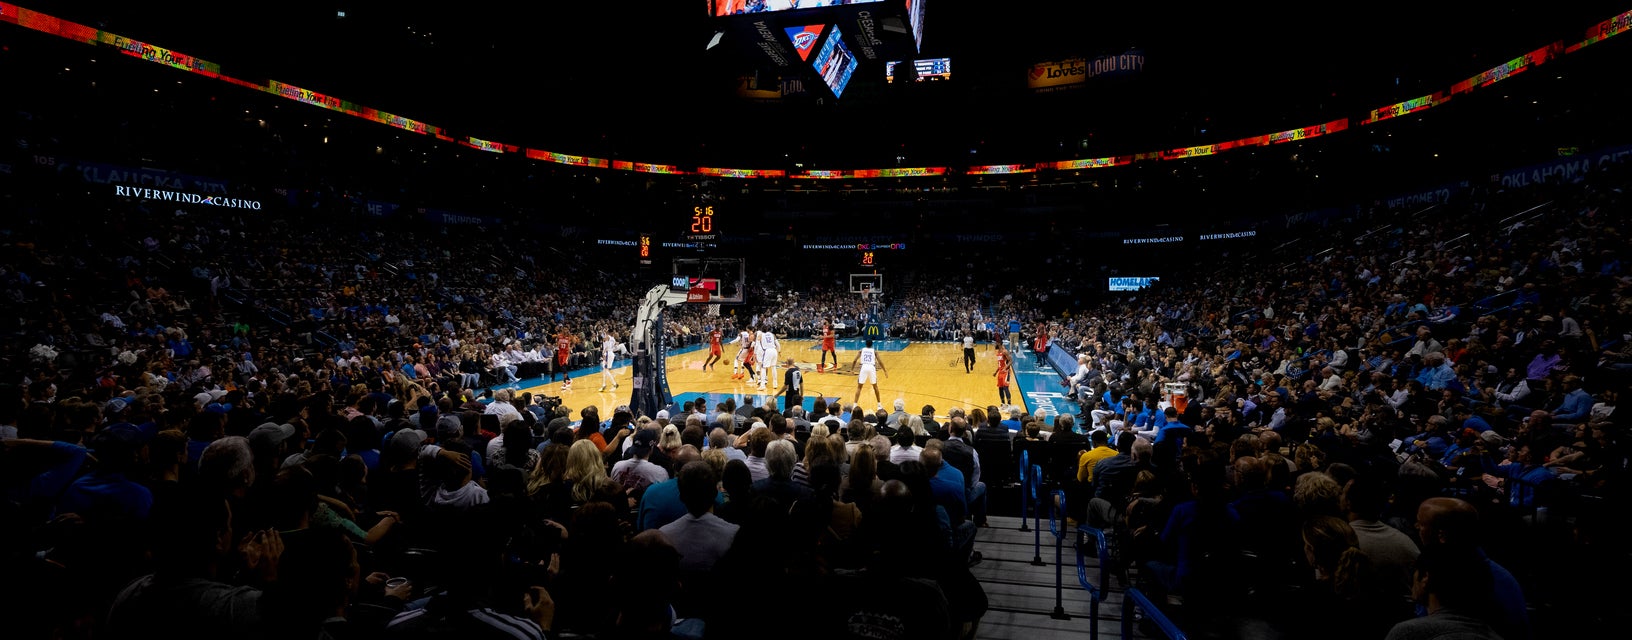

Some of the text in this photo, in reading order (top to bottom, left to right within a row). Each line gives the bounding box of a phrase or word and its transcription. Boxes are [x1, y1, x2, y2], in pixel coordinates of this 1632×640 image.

[115, 36, 156, 60] Fueling
[159, 49, 187, 66] Your
[1088, 54, 1145, 78] LOUD CITY
[783, 79, 806, 96] LOU
[115, 185, 262, 211] RIVERWIND CASINO
[695, 206, 714, 216] 5:16
[691, 217, 711, 232] 20
[862, 257, 874, 265] 20
[1110, 278, 1153, 288] HOMELAN
[863, 354, 873, 363] 23
